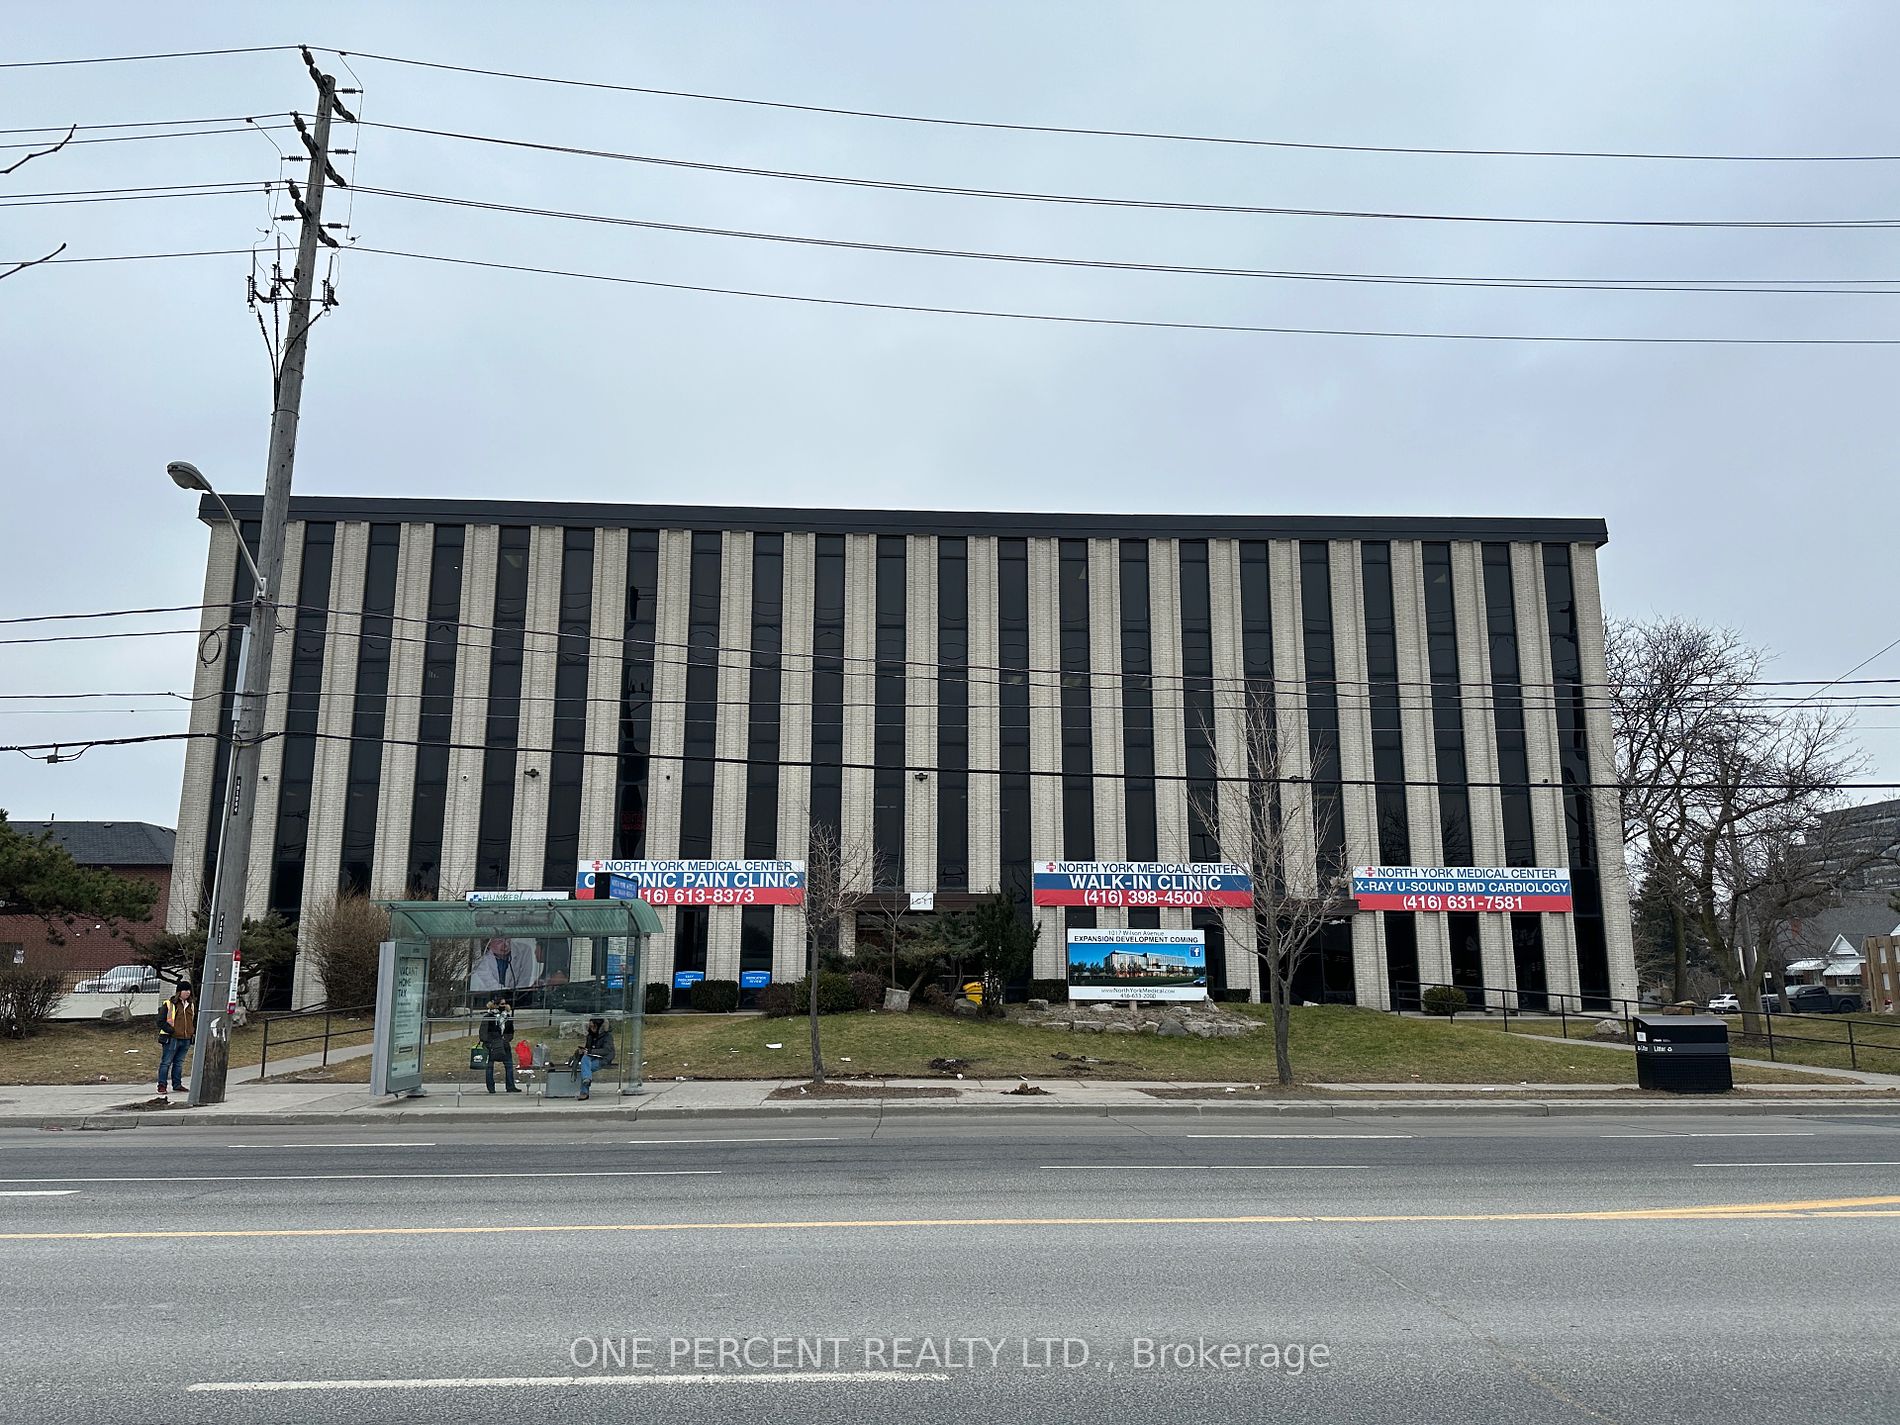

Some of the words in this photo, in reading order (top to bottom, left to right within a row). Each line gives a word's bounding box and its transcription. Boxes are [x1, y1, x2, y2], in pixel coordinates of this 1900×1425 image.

[605, 861, 647, 871] NORTH
[651, 861, 684, 871] YORK
[688, 861, 741, 871] MEDICAL
[744, 861, 792, 871] CENTER
[1058, 863, 1099, 873] NORTH
[1102, 863, 1134, 873] YORK
[1137, 863, 1189, 874] MEDICAL
[1192, 864, 1238, 874] CENTER
[1377, 867, 1418, 878] NORTH
[1421, 868, 1454, 878] YORK
[1457, 868, 1508, 878] MEDICAL
[1511, 869, 1557, 879] CENTER
[584, 872, 677, 889] CONIC
[683, 872, 728, 888] PAIN
[733, 872, 799, 888] CLINIC
[1069, 874, 1152, 890] WALK-IN
[1157, 875, 1222, 891] CLINIC
[1355, 881, 1394, 892] X-RAY
[1397, 881, 1454, 893] U-SOUND
[1457, 882, 1486, 893] BMD
[1488, 882, 1569, 893] CARDIOLOGY
[674, 889, 755, 904] 613-8373
[1084, 889, 1123, 906] (416)
[1127, 890, 1203, 905] 398-4500
[1403, 895, 1442, 910] (416)
[1447, 896, 1523, 910] 631-7581
